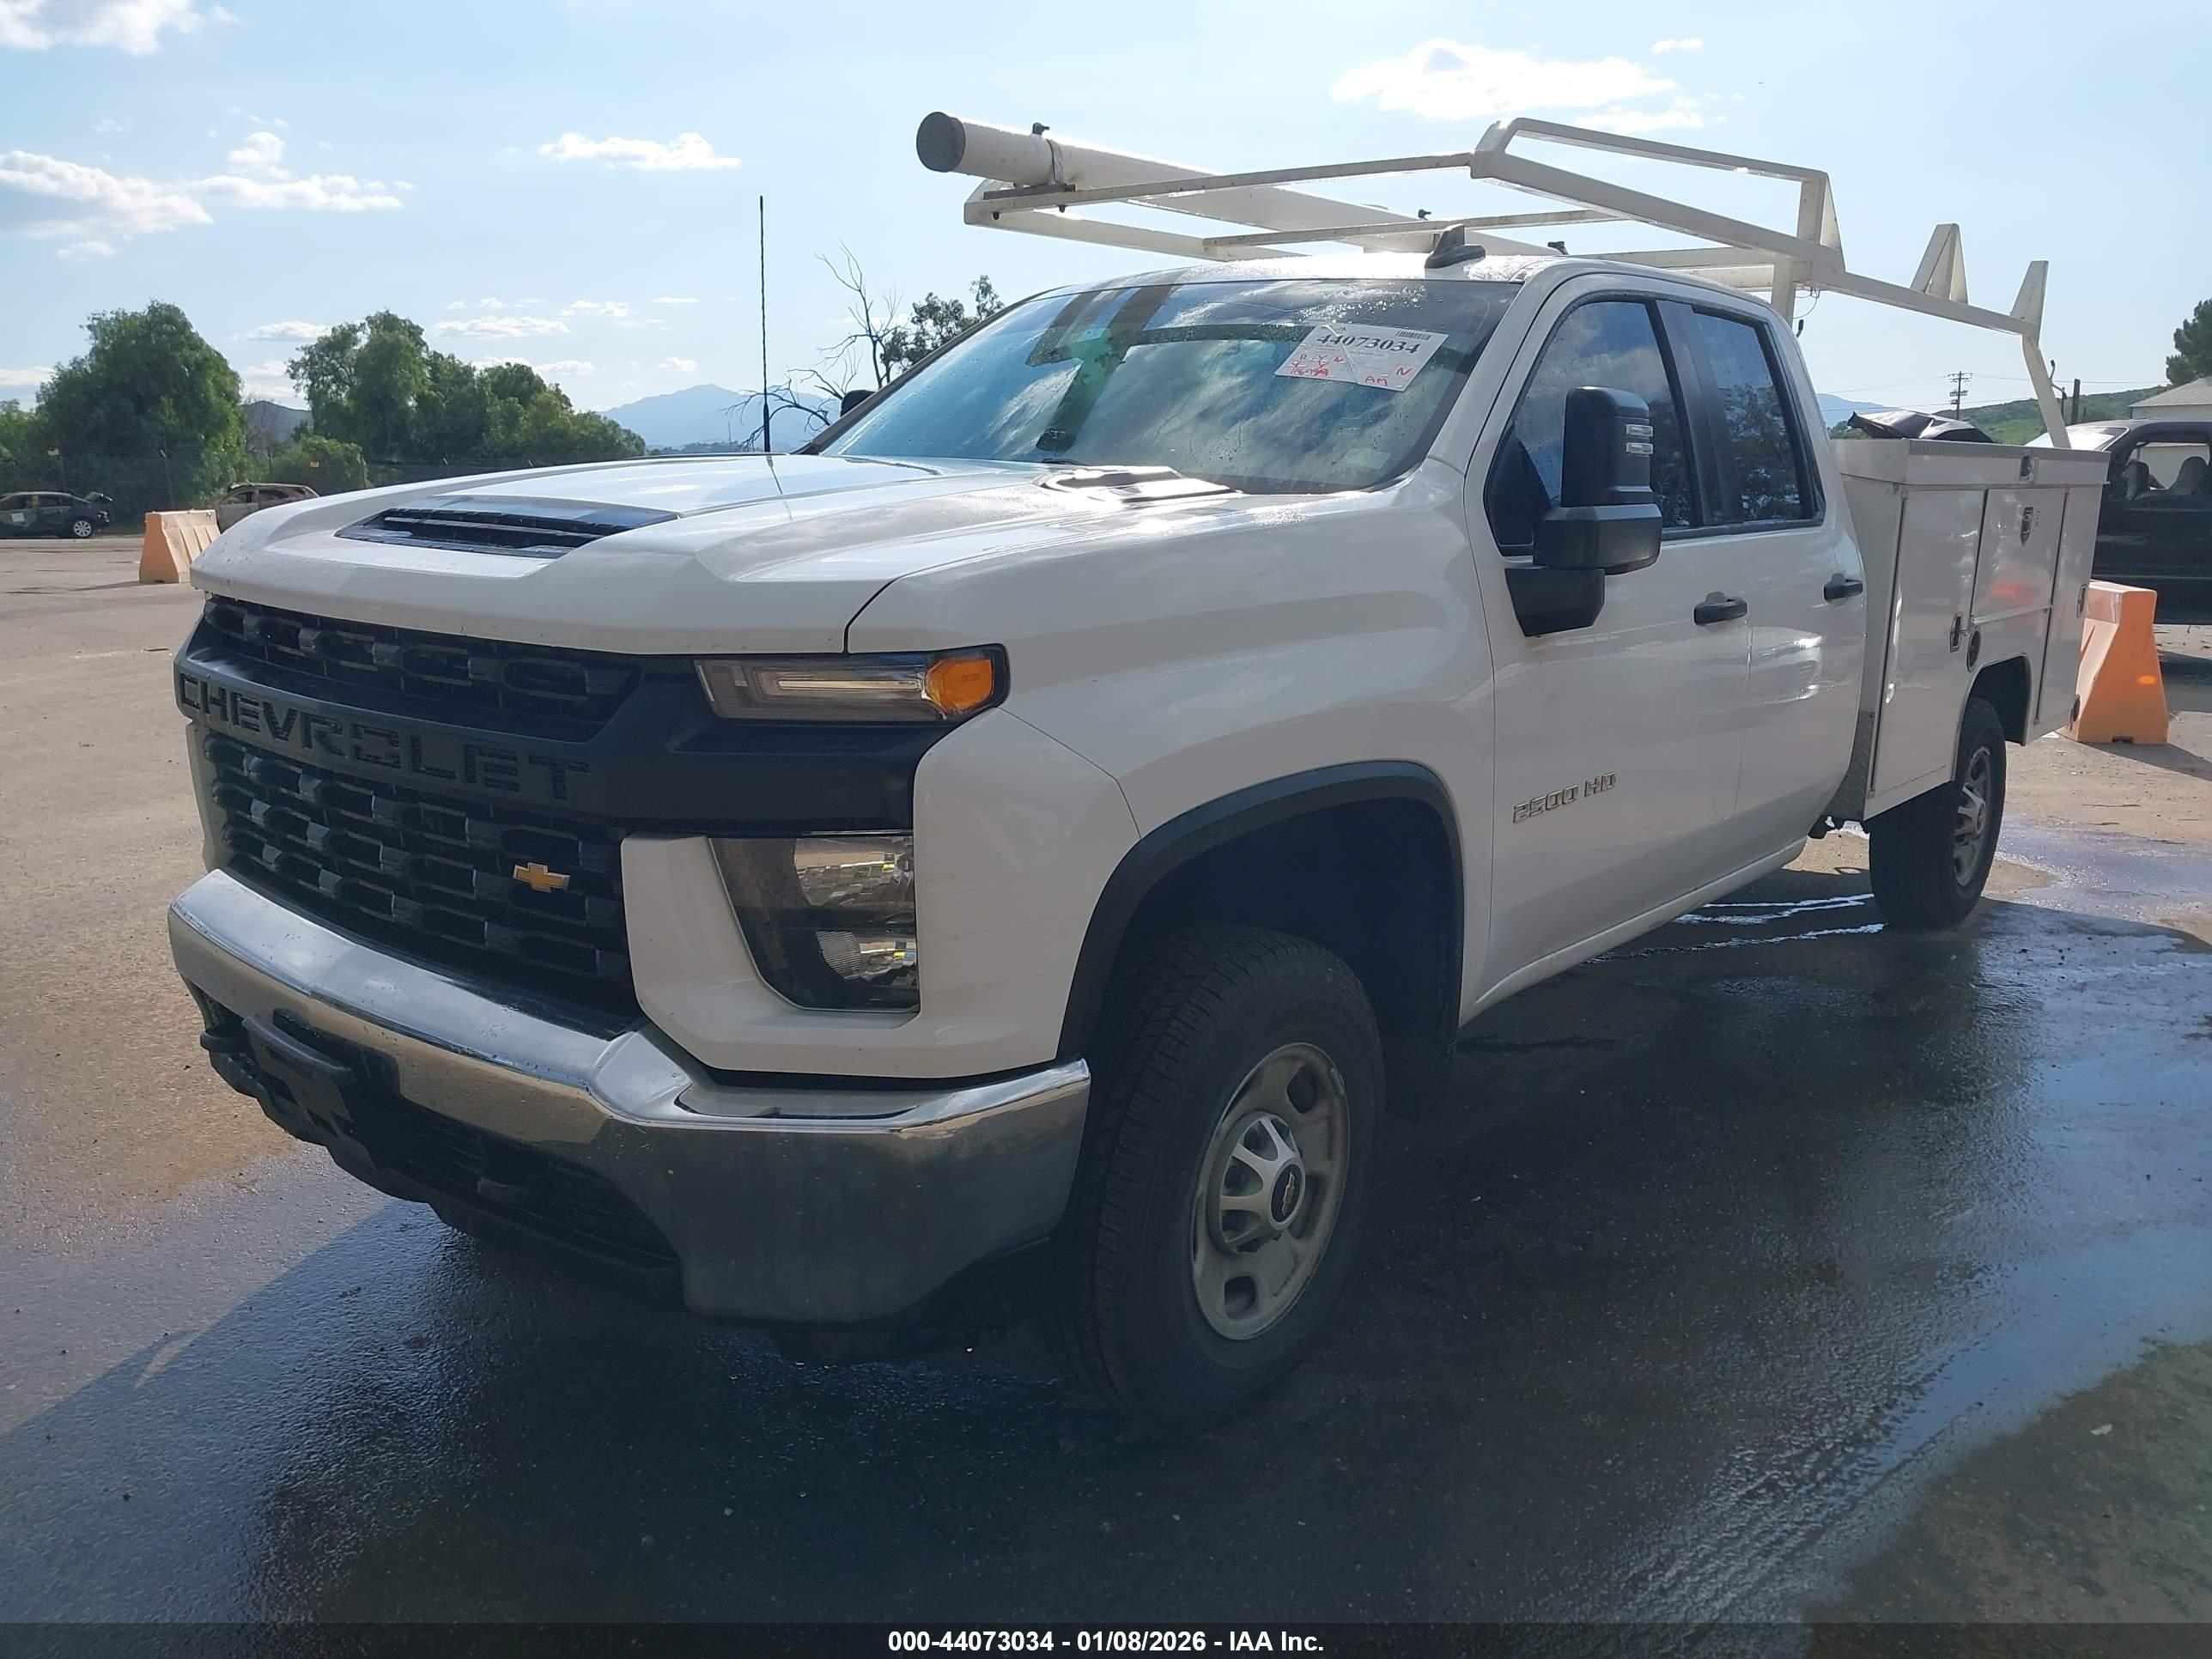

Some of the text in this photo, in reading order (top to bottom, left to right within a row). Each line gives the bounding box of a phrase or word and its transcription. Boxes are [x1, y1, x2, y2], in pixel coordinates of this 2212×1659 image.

[1316, 333, 1421, 354] 44073034
[179, 673, 591, 801] CHEVROLET
[1512, 771, 1617, 823] 2500 HD
